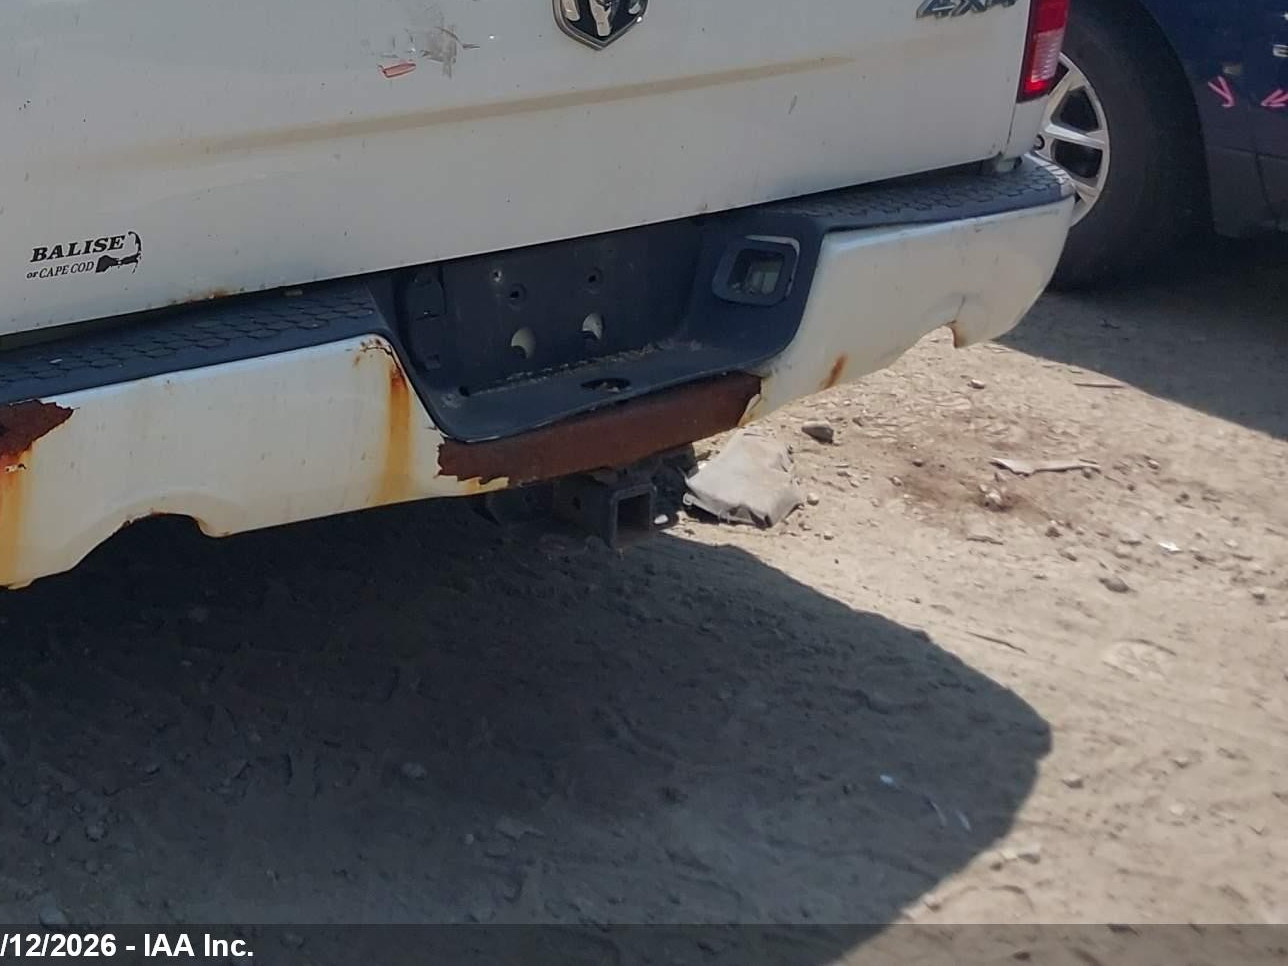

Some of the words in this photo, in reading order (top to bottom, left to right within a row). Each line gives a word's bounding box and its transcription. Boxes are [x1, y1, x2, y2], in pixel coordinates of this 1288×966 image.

[30, 234, 126, 263] BALISE
[39, 264, 70, 279] CAPE
[70, 261, 95, 275] COD
